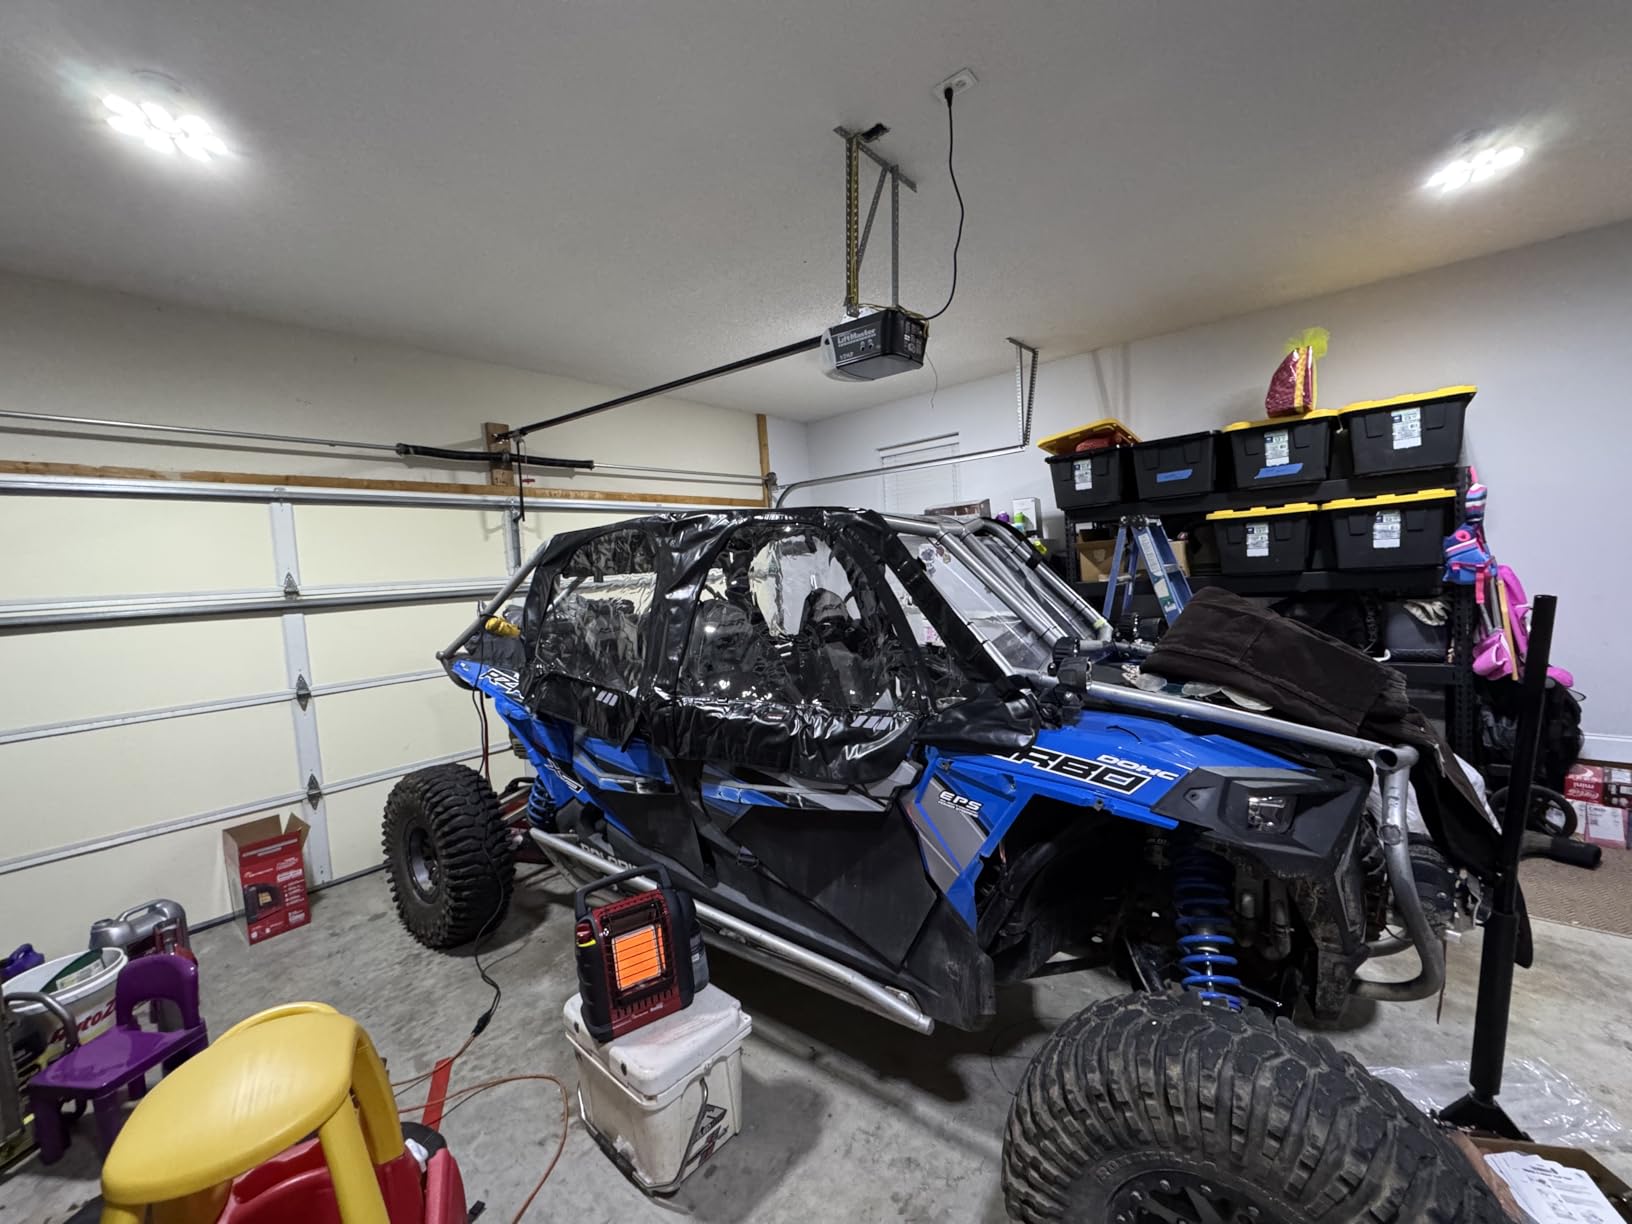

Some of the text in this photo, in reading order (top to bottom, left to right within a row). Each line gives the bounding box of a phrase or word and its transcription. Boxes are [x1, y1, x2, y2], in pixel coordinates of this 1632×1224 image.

[993, 745, 1152, 795] RBO
[1096, 754, 1179, 781] DOHC
[939, 790, 982, 811] EPS
